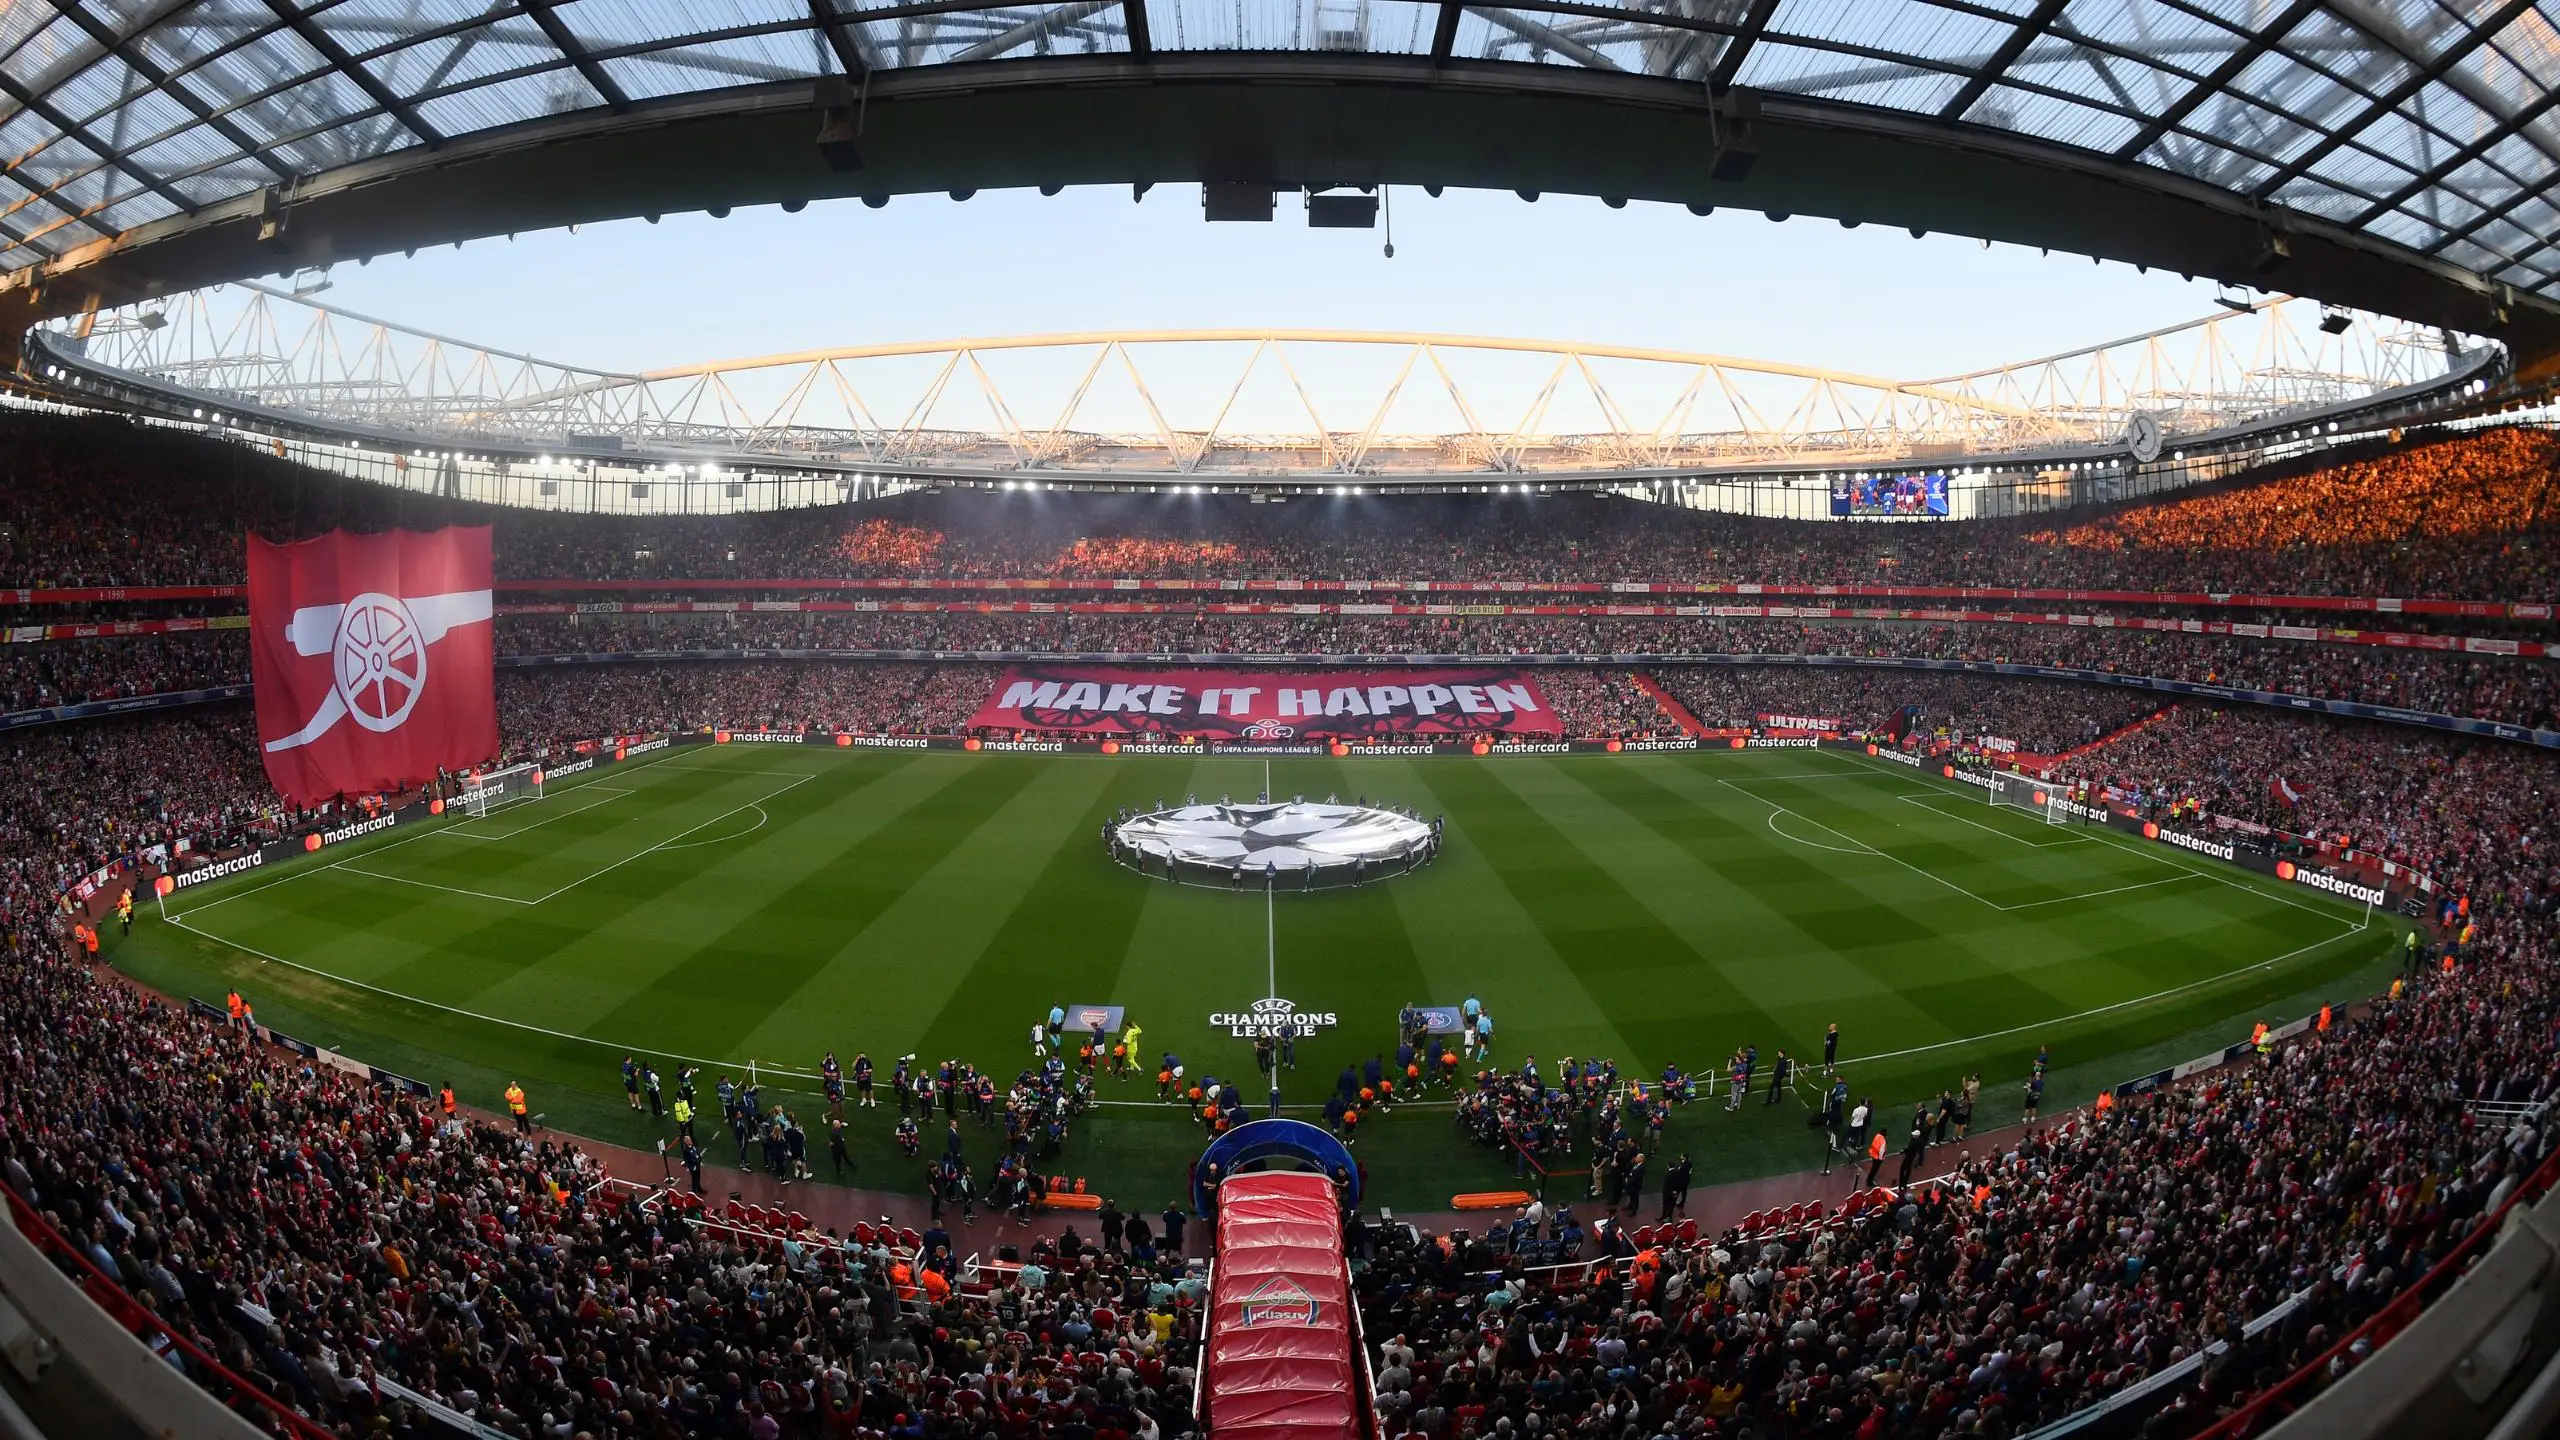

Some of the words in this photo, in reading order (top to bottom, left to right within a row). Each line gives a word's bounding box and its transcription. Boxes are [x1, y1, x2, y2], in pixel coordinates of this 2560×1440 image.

[585, 604, 614, 612] SLIGO
[990, 604, 1013, 612] Arsenal
[75, 627, 98, 636] Arsenal
[997, 682, 1186, 714] MAKE
[1199, 687, 1260, 715] IT
[1278, 684, 1538, 716] HAPPEN
[1770, 716, 1830, 730] ULTRAS
[733, 733, 803, 744] mastercard
[854, 735, 928, 748] mastercard
[1625, 739, 1697, 750] mastercard
[1747, 736, 1818, 748] mastercard
[626, 737, 669, 757] mastercard
[984, 741, 1063, 752] mastercard
[1122, 743, 1204, 754] mastercard
[1352, 743, 1433, 755] mastercard
[1492, 742, 1570, 754] mastercard
[1879, 747, 1920, 767] mastercard
[546, 757, 593, 780] mastercard
[1955, 770, 2004, 792] mastercard
[446, 782, 504, 809] mastercard
[2048, 796, 2108, 823] mastercard
[324, 812, 395, 845] mastercard
[2160, 828, 2234, 861] mastercard
[176, 850, 262, 888] mastercard
[2297, 866, 2384, 906] mastercard
[1253, 1000, 1292, 1012] UEFA
[1210, 1013, 1337, 1025] CHAMPIONS
[1002, 1309, 1014, 1320] 19
[1252, 1310, 1308, 1321] Arsenal
